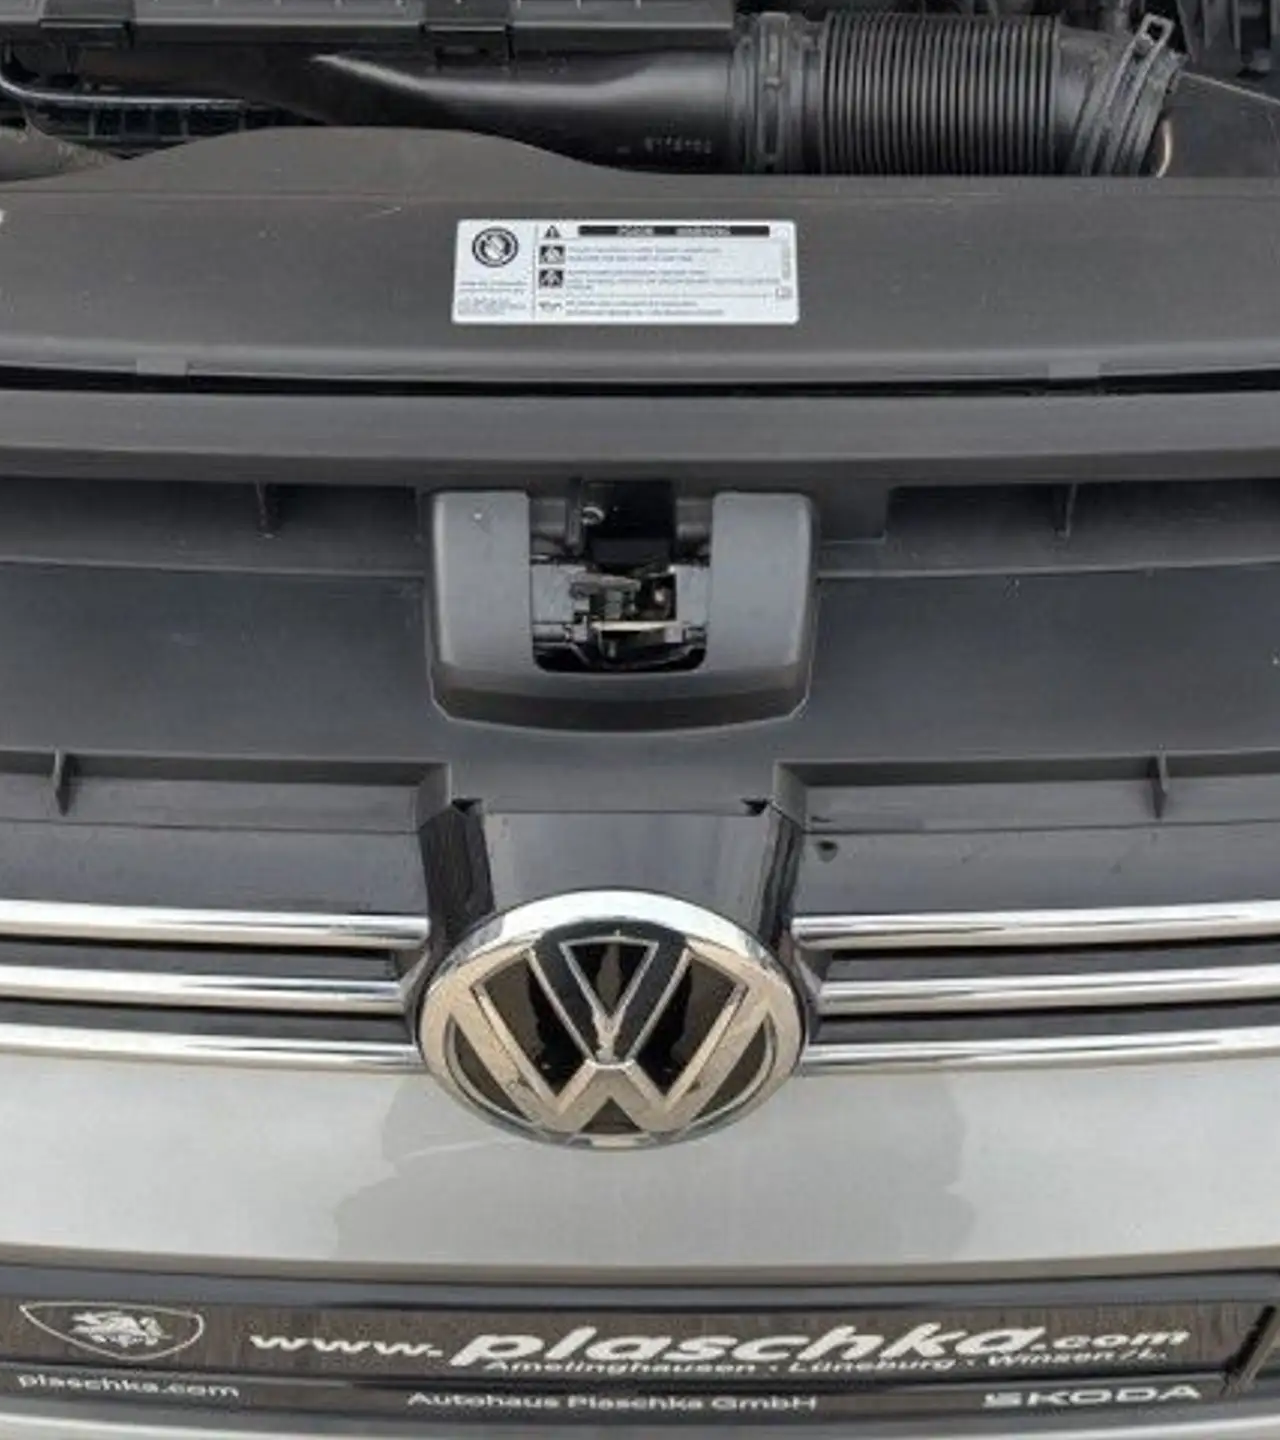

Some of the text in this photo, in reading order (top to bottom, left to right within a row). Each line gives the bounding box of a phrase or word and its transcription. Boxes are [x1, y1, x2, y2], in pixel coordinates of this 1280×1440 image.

[249, 1322, 1191, 1366] www.plaschka.com
[483, 1360, 757, 1375] Amelinghausen
[17, 1373, 240, 1398] plaschka.com
[406, 1392, 557, 1408] Autohaus
[567, 1393, 703, 1410] Plaschka
[711, 1393, 818, 1410] GmbH
